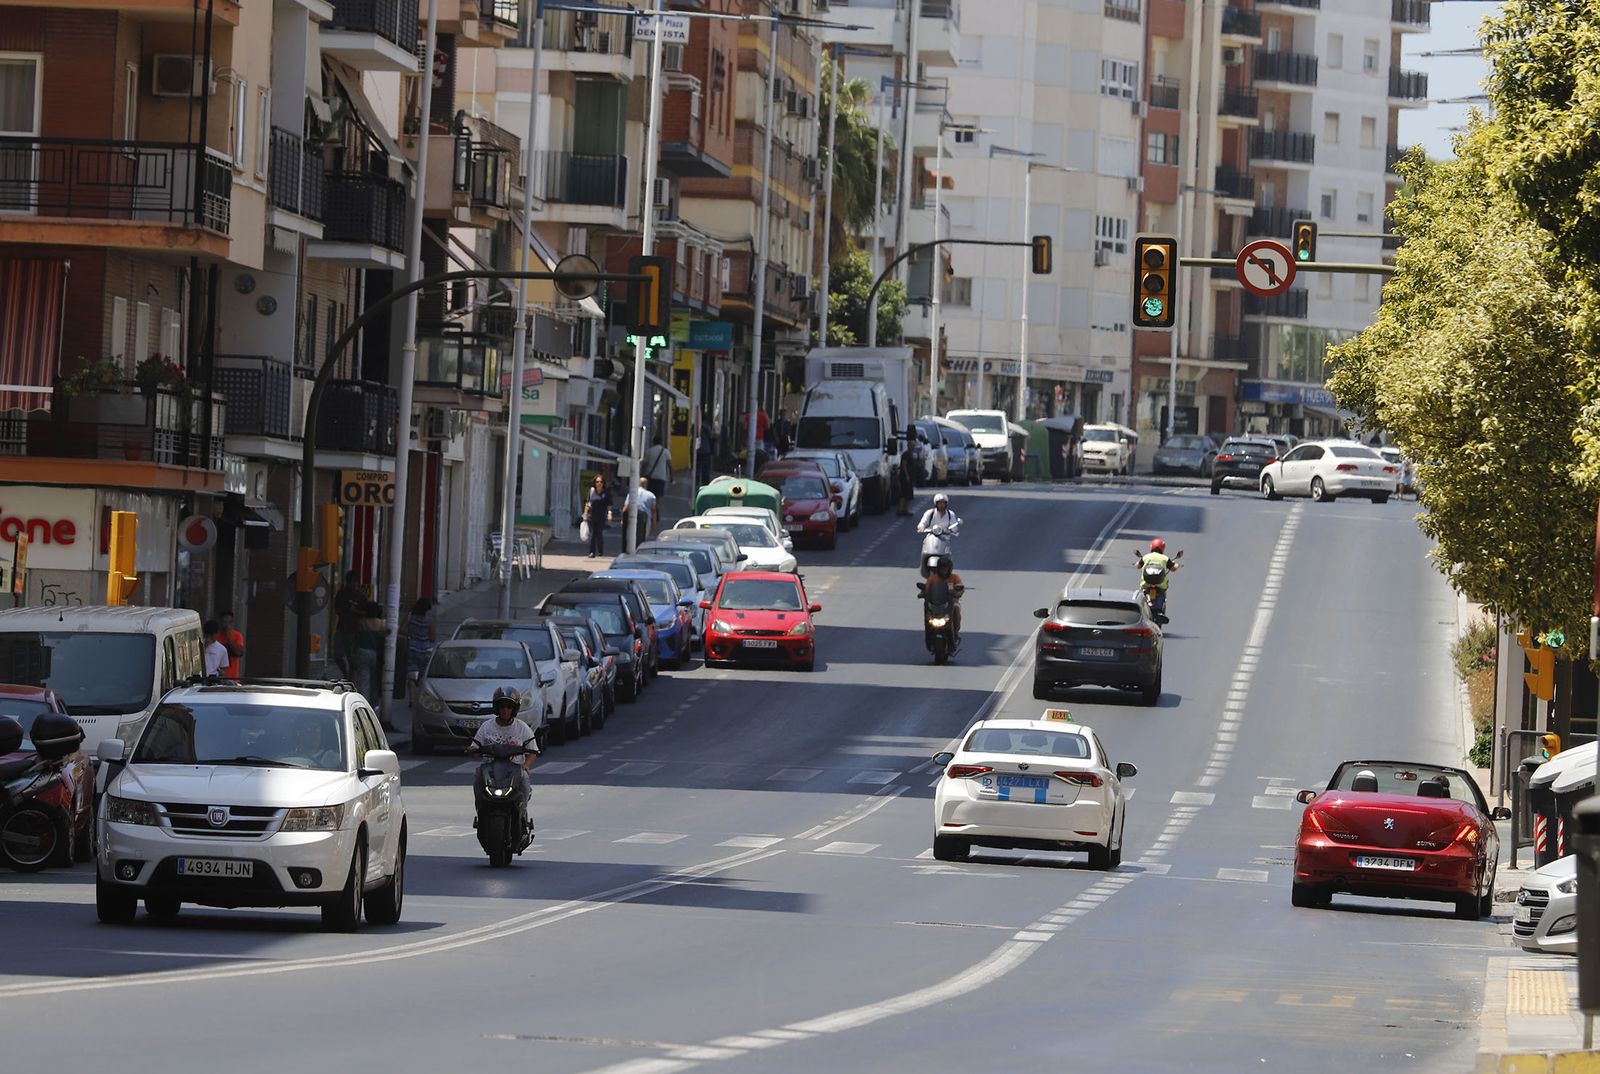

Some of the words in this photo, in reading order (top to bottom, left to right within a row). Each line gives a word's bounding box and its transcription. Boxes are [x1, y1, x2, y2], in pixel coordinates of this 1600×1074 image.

[637, 29, 685, 38] DENISTA
[356, 472, 388, 481] COMPRO
[0, 514, 76, 545] one
[1052, 710, 1067, 720] TAXI
[1364, 858, 1390, 868] 3734
[187, 861, 220, 874] 4934
[225, 862, 251, 876] HJN
